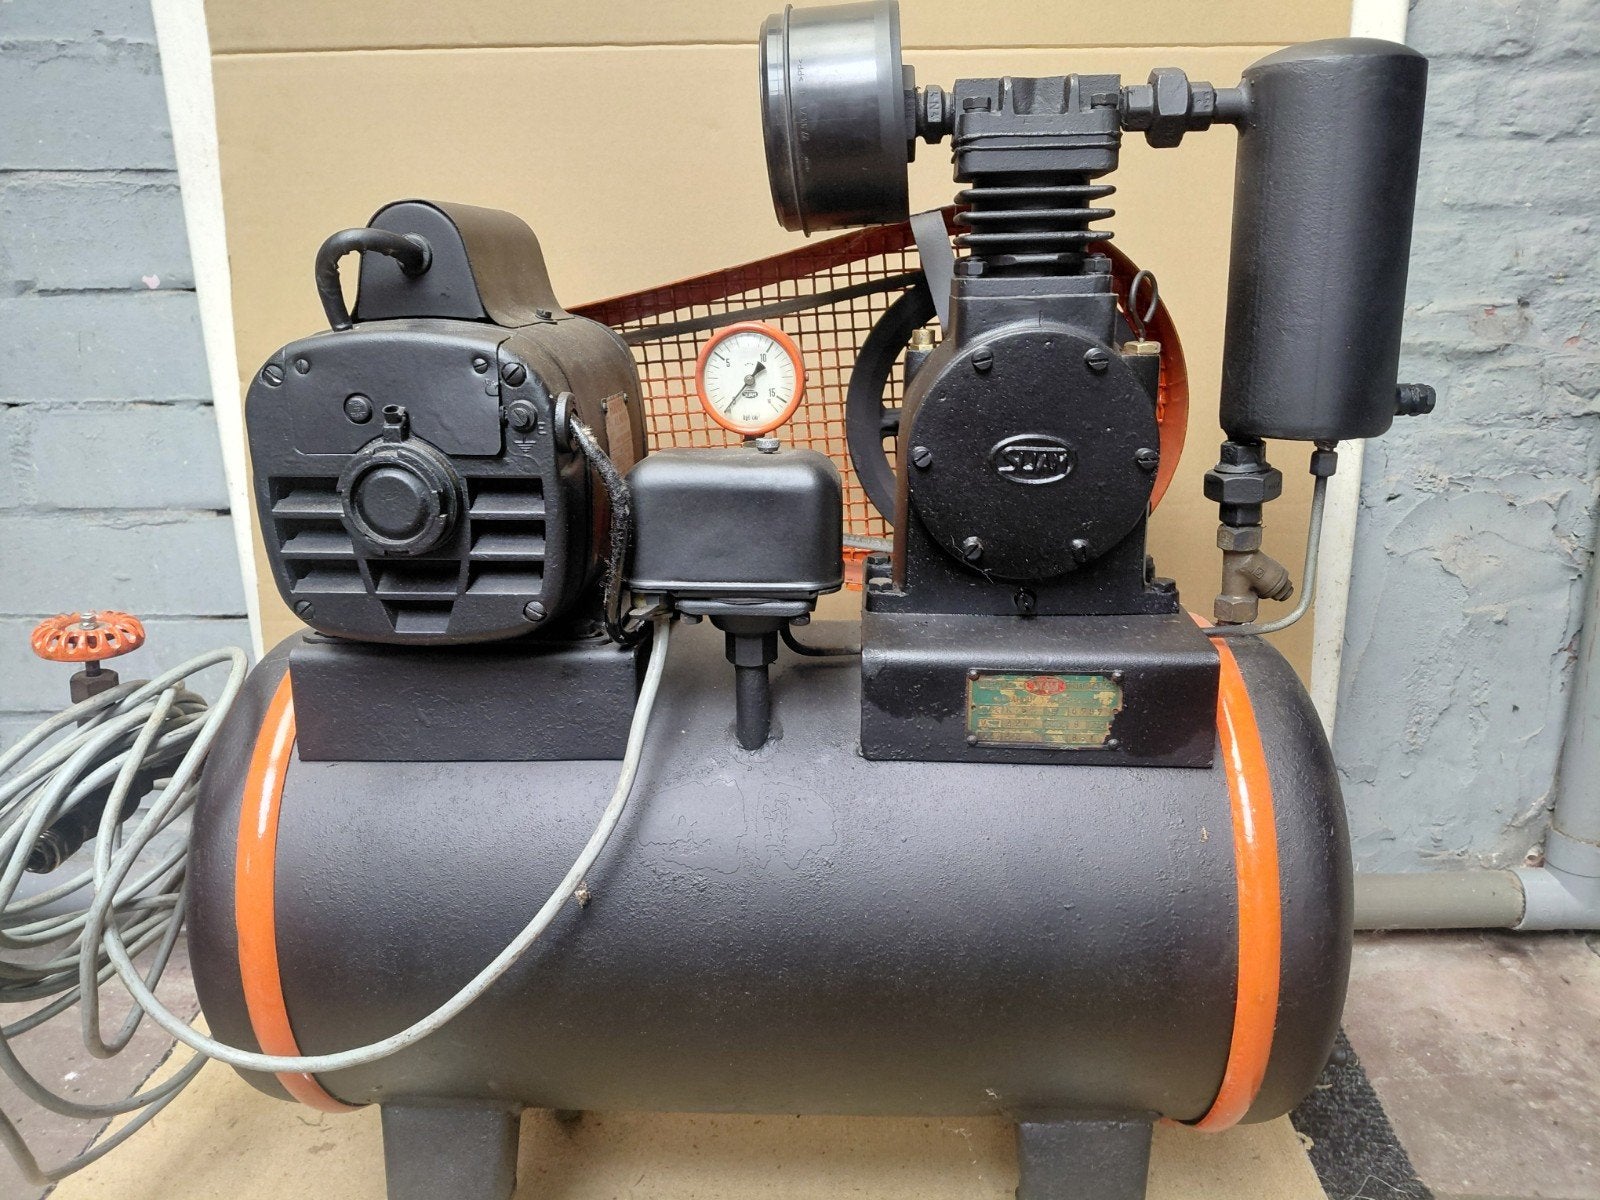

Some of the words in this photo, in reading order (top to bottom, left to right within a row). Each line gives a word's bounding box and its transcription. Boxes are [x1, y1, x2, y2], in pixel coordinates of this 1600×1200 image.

[725, 358, 731, 368] 5
[760, 353, 767, 363] 10
[769, 388, 776, 397] 15
